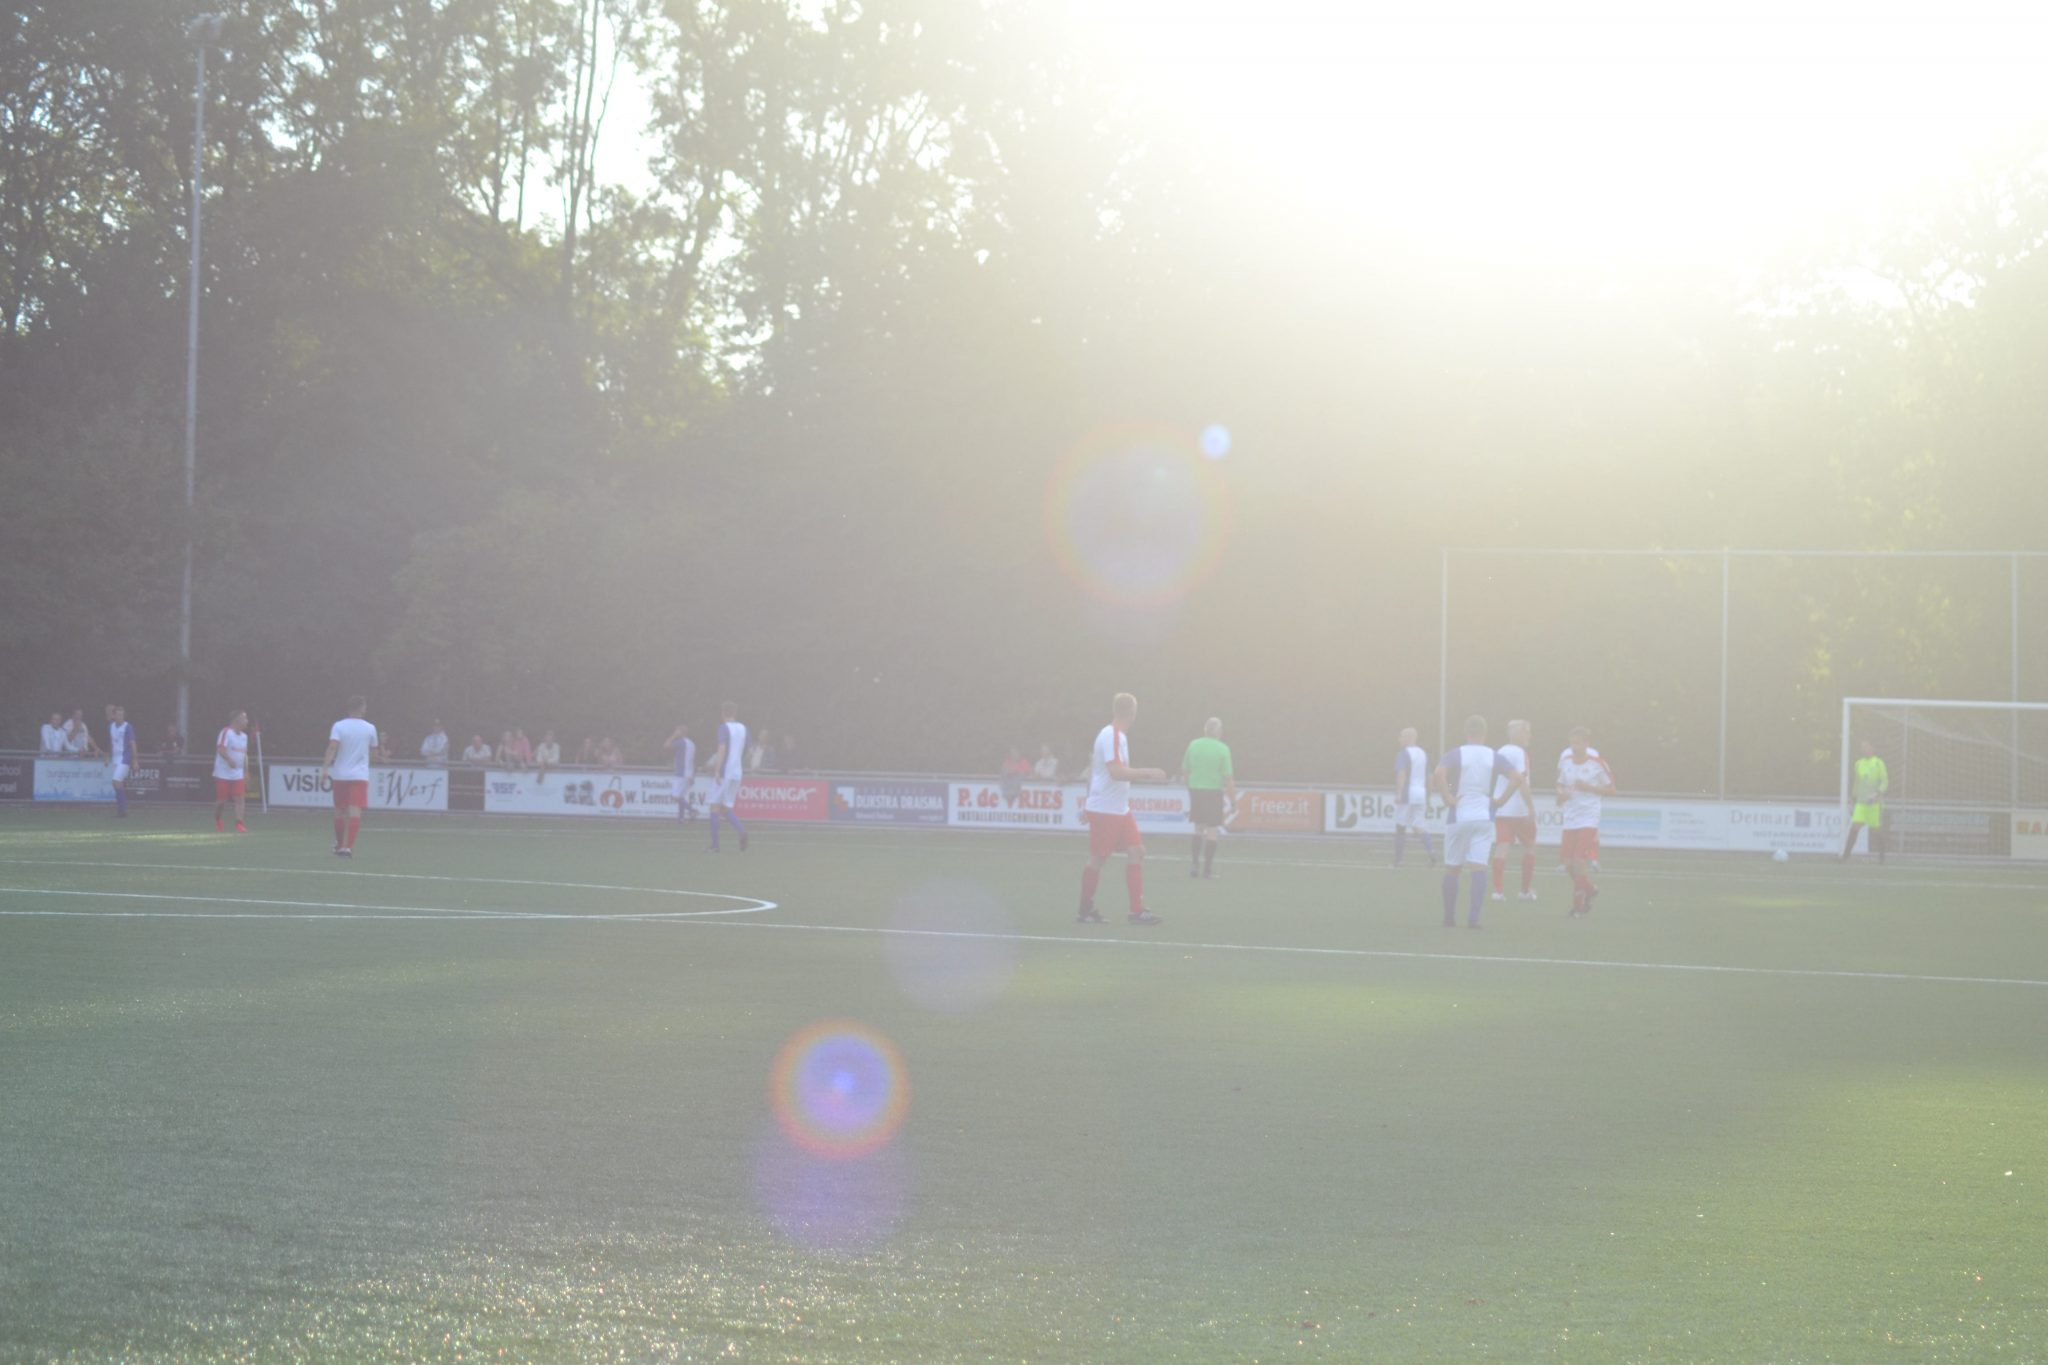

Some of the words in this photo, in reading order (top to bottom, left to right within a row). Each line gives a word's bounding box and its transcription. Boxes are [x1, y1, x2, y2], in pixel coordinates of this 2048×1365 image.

[739, 785, 808, 802] OKKINGA
[957, 788, 973, 807] P.
[977, 787, 999, 808] de
